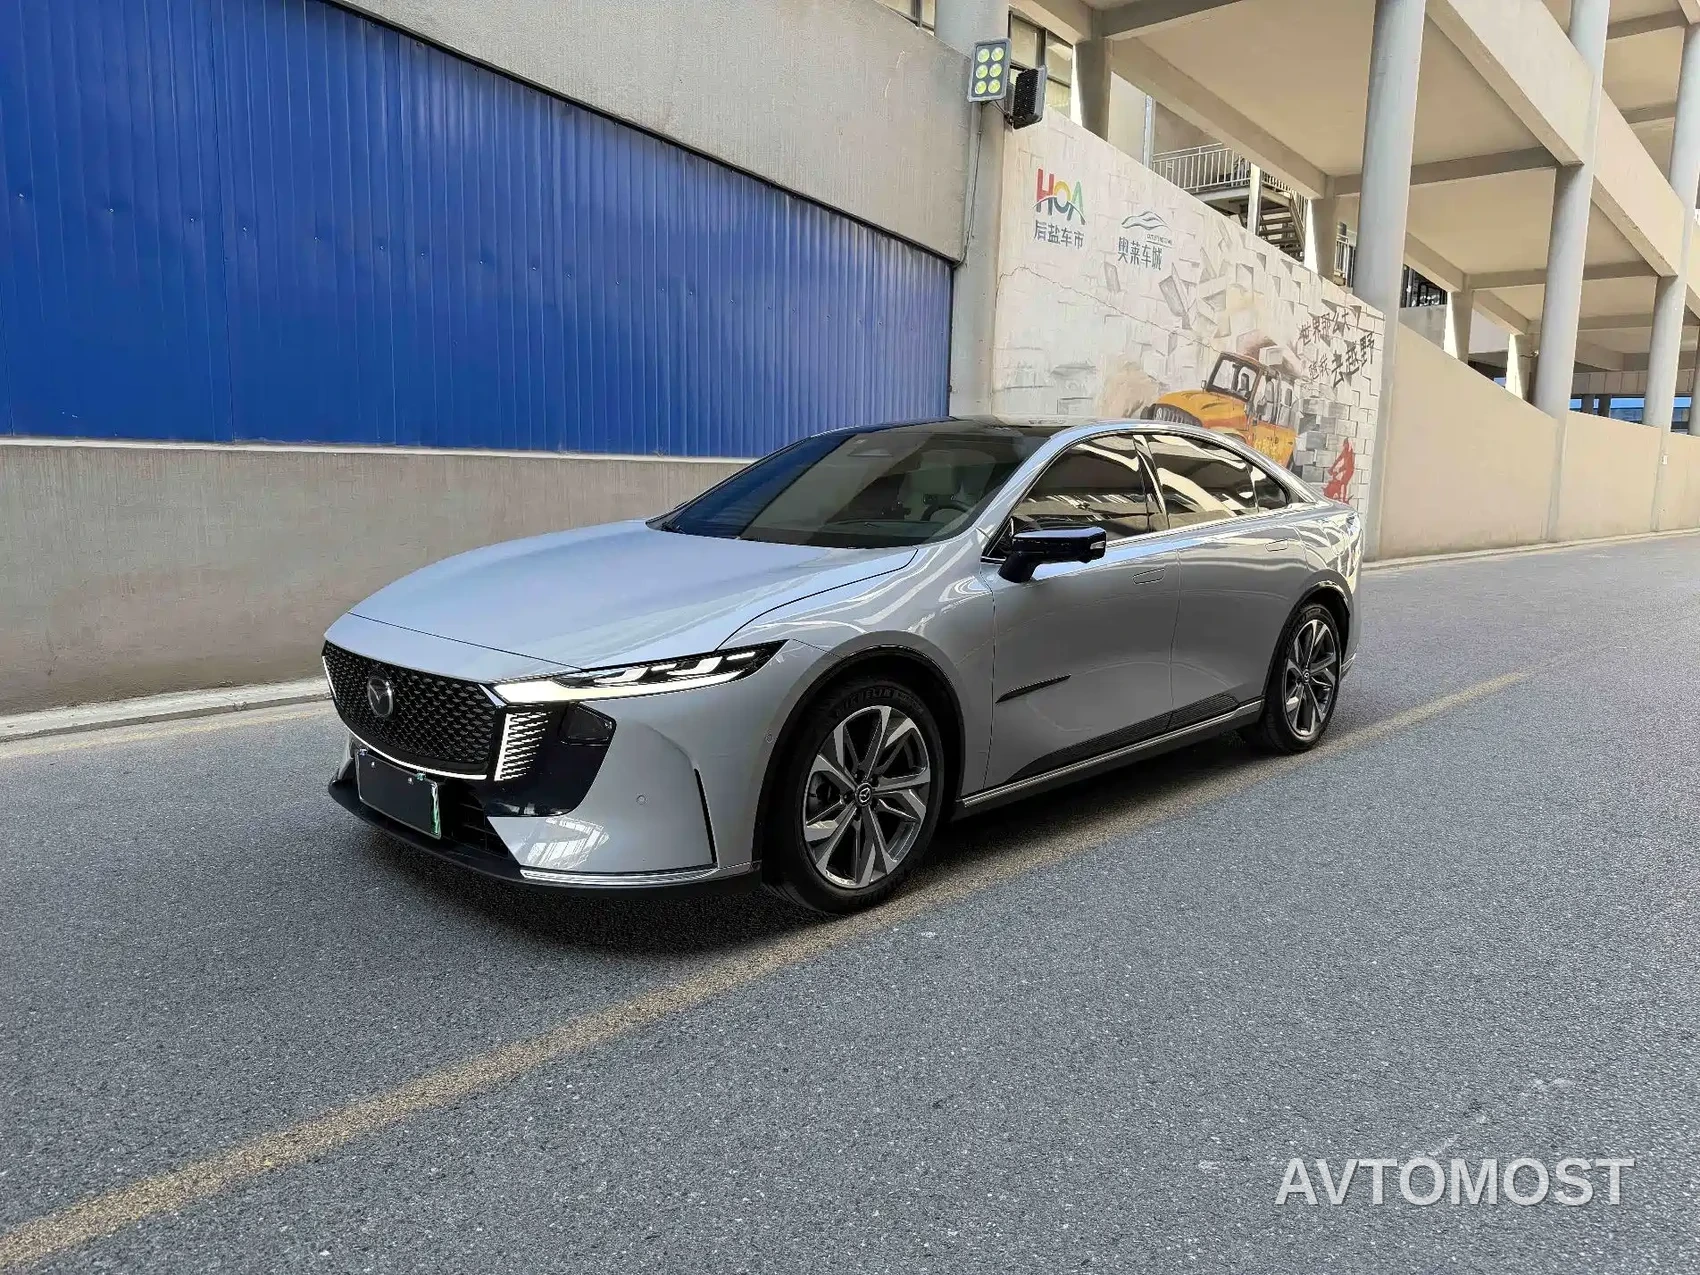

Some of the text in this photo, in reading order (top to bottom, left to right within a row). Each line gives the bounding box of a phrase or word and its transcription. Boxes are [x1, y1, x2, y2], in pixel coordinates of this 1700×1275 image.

[1033, 168, 1086, 225] HOA
[1034, 219, 1085, 249] 后盐车市
[1118, 236, 1163, 271] 奥莱车城
